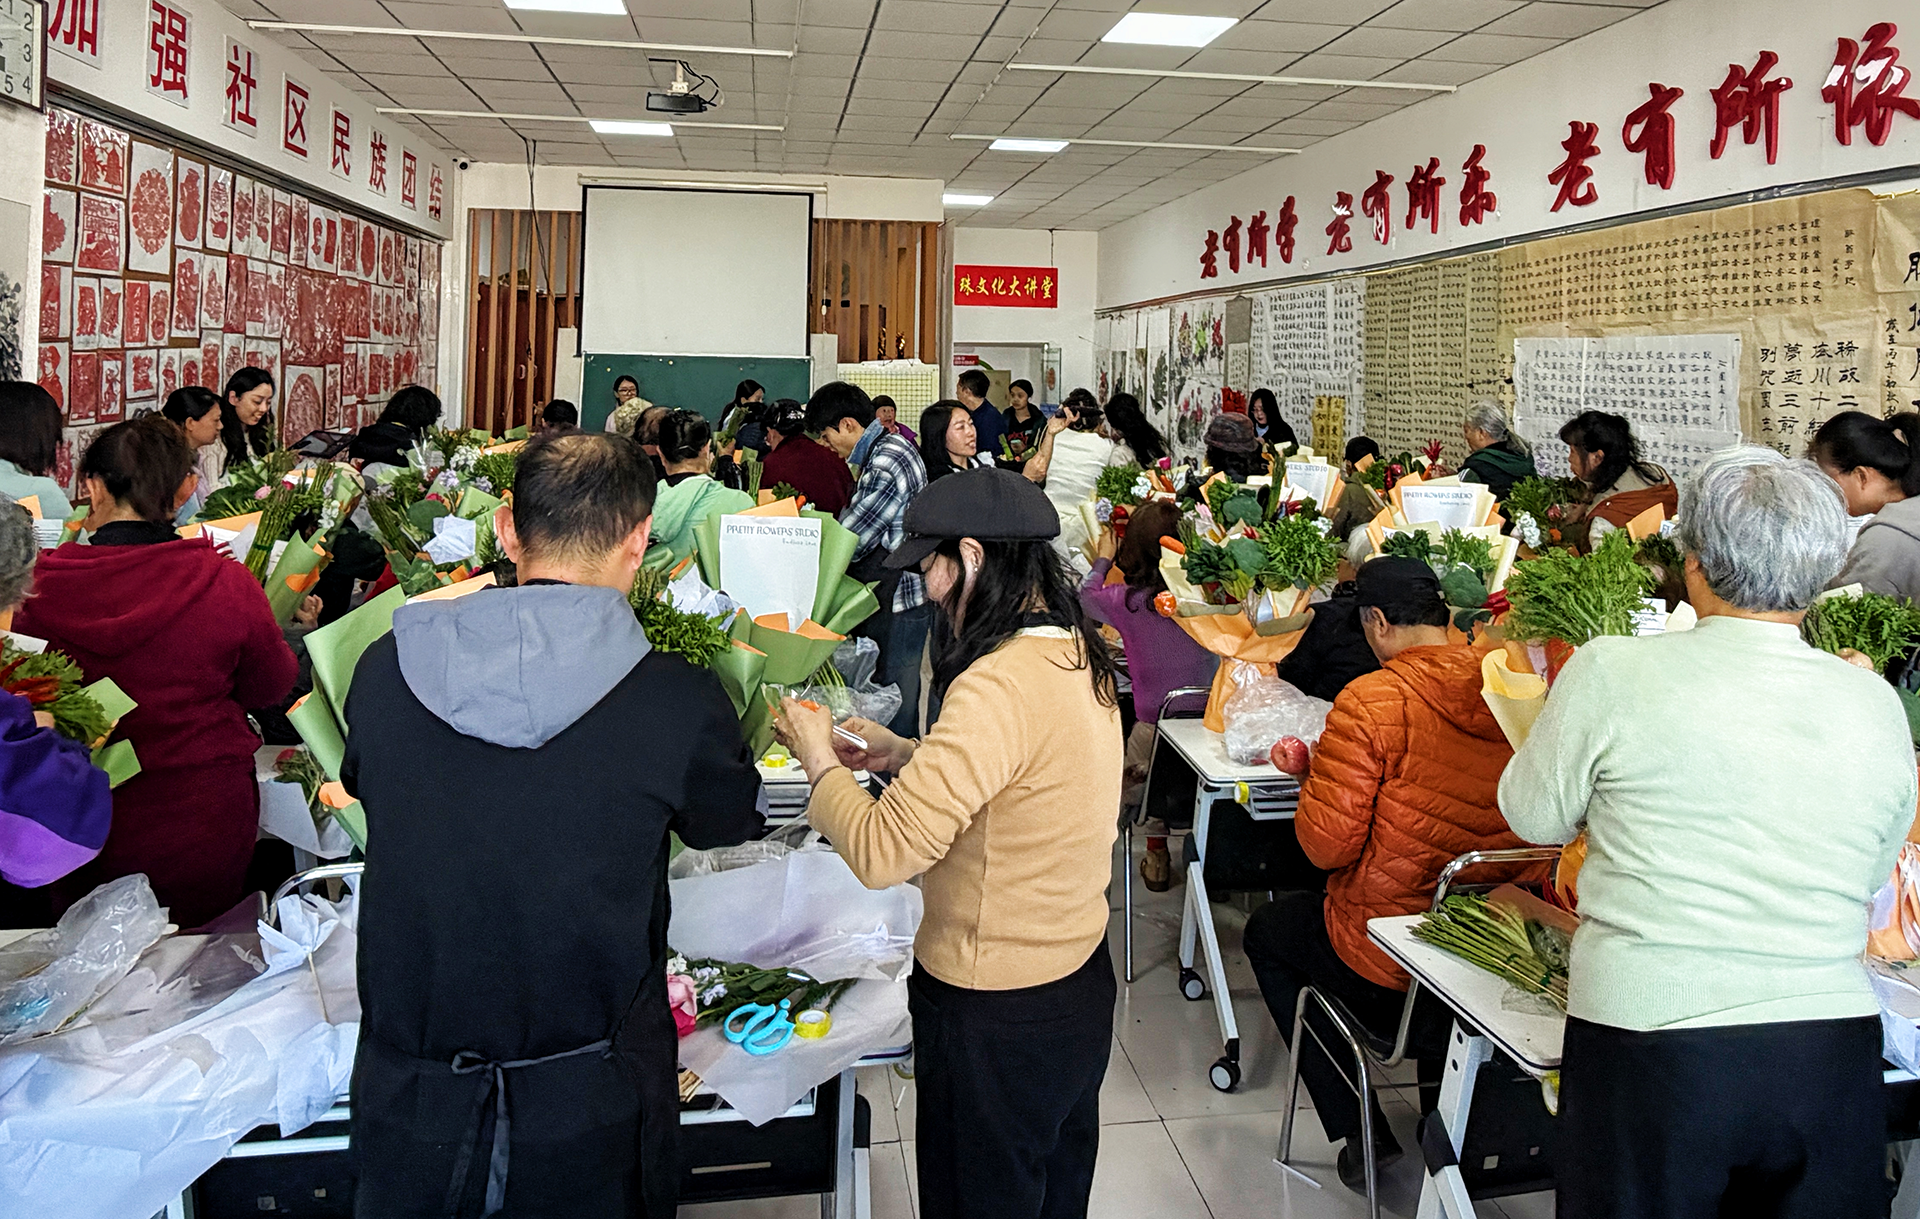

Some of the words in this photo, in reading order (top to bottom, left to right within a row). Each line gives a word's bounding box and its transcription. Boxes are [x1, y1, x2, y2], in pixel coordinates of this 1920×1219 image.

[24, 12, 34, 32] 2
[23, 43, 32, 63] 3
[4, 74, 14, 94] 5
[22, 76, 32, 94] 4
[726, 524, 755, 535] PRETTY
[756, 526, 794, 537] FLOWERS
[795, 527, 820, 539] STUDIO
